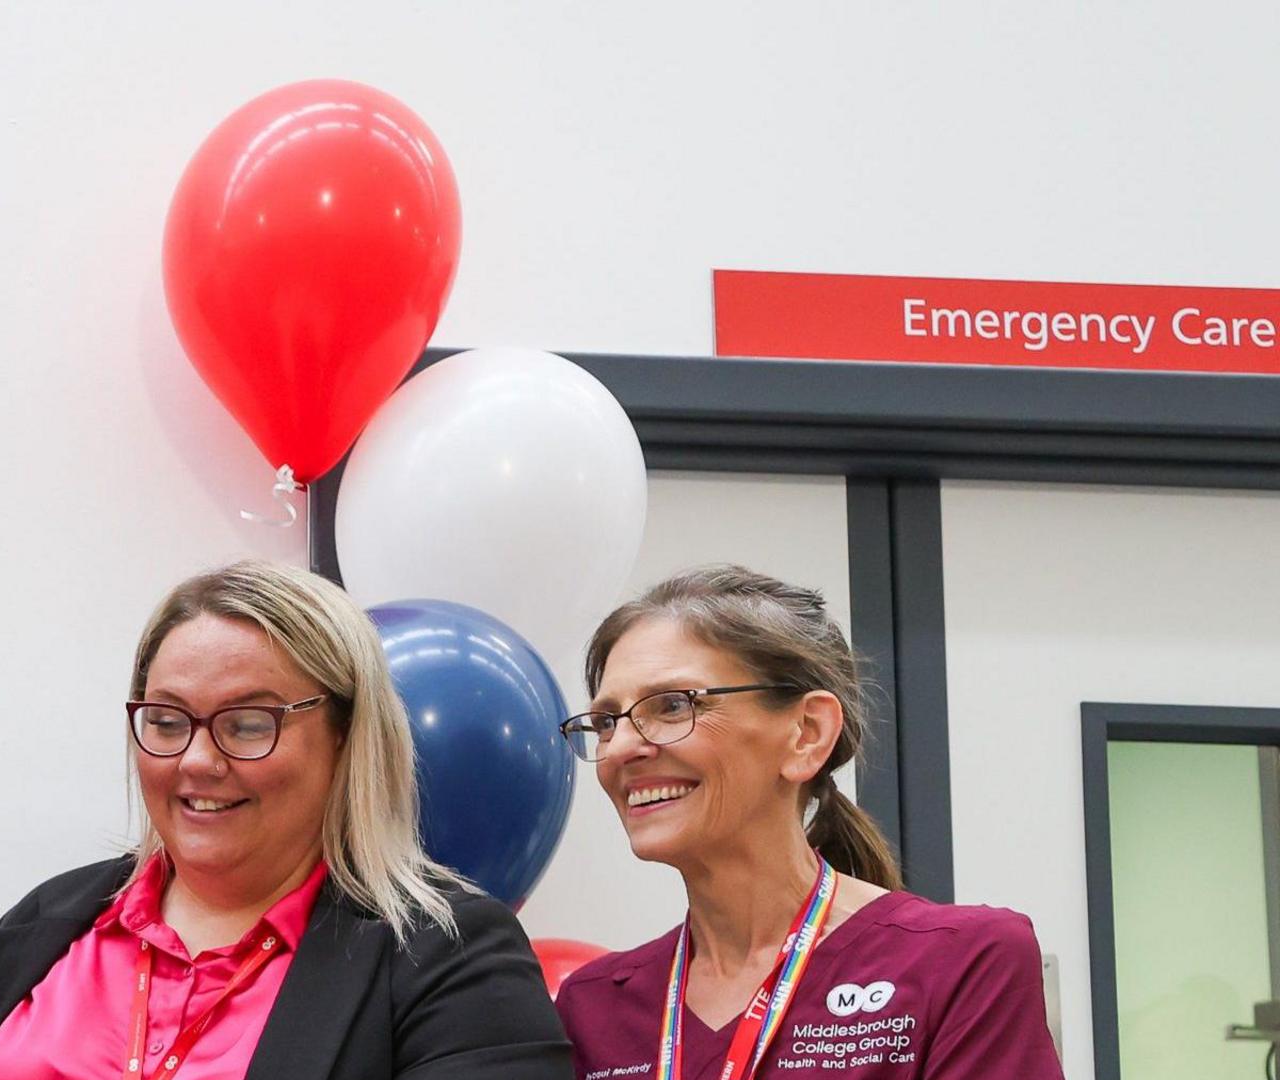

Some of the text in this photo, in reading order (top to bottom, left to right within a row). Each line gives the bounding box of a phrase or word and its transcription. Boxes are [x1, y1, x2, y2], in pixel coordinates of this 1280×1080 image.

[903, 298, 1276, 353] Emergency Care
[795, 924, 818, 954] NHS
[745, 987, 771, 1021] TTE
[771, 981, 792, 1012] NHS
[793, 1014, 916, 1038] Middlesbrough
[661, 1036, 672, 1066] NHS
[778, 1052, 915, 1069] Health and Social Care
[792, 1035, 910, 1058] College Group
